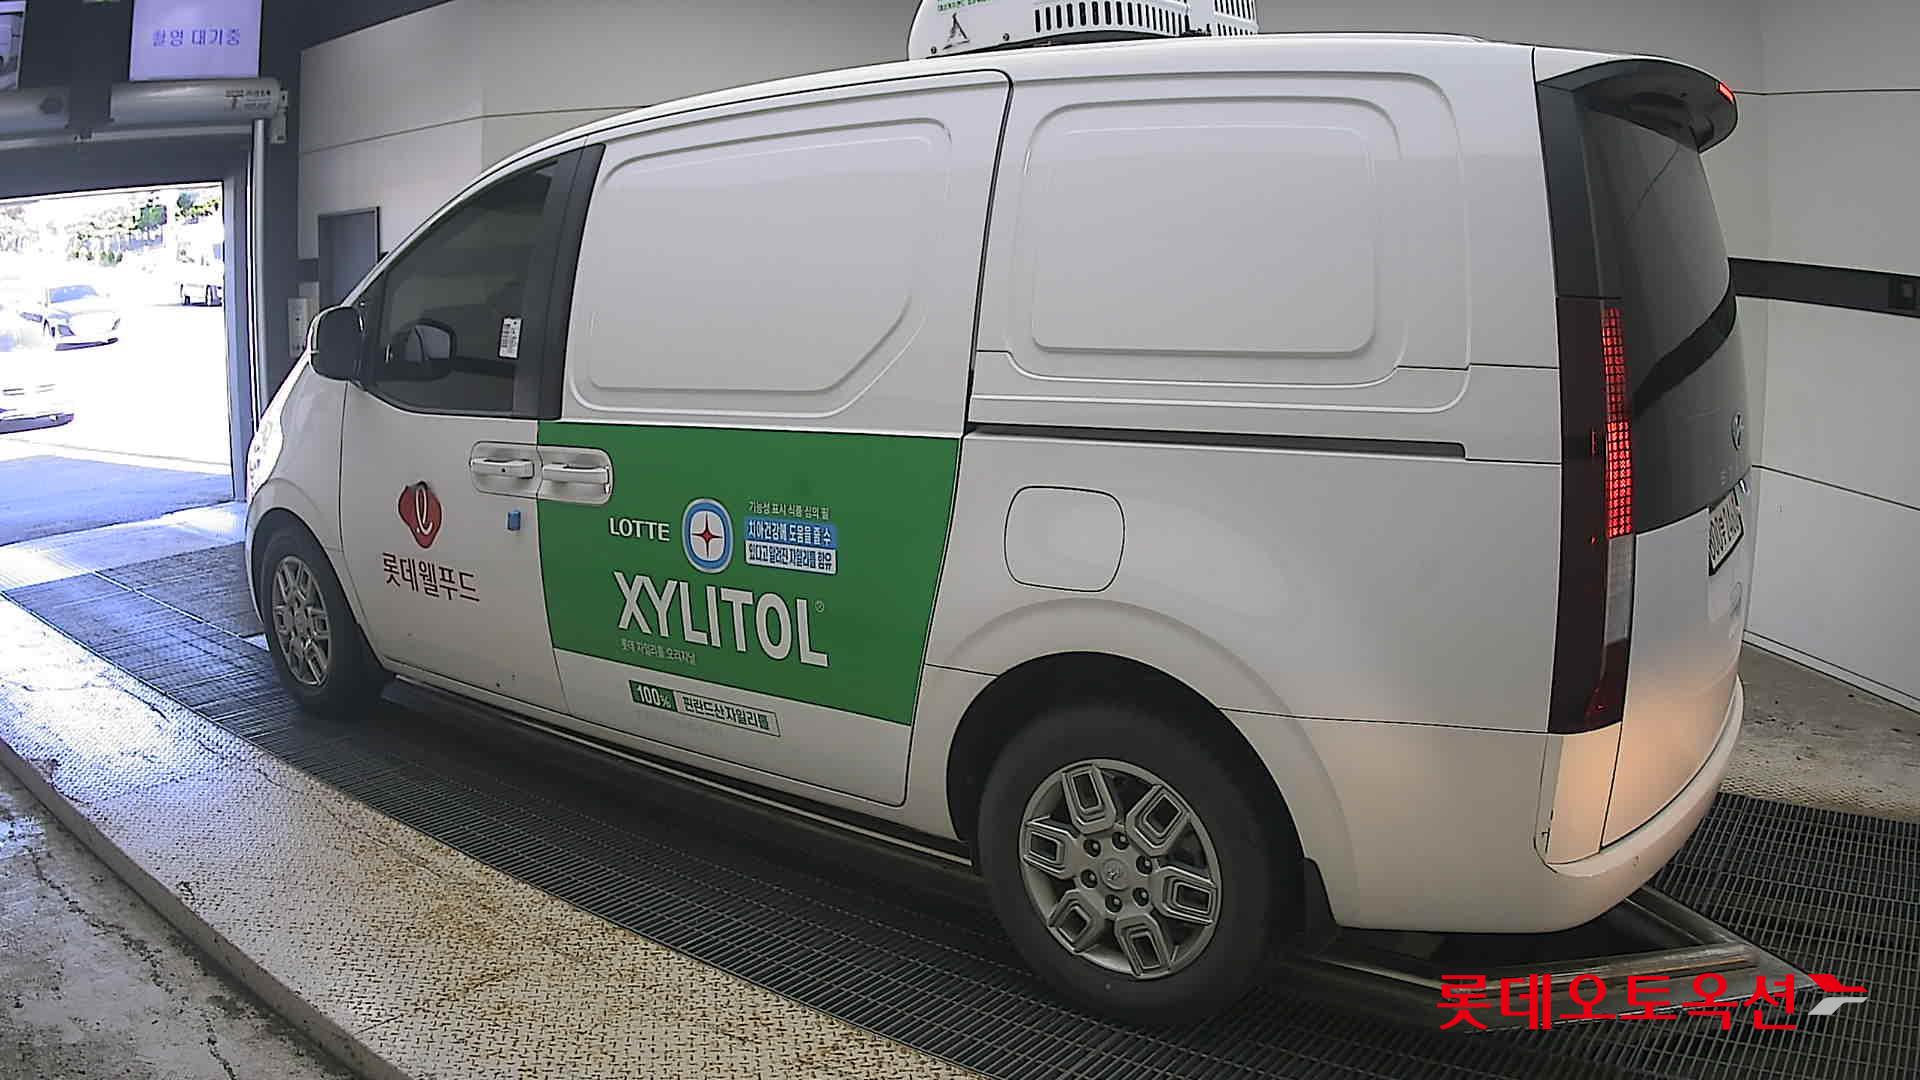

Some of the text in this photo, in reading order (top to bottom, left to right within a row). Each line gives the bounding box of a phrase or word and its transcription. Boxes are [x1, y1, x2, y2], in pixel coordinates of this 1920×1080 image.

[191, 27, 241, 47] 대기중
[772, 503, 787, 516] 표시
[609, 517, 671, 542] LOTTE
[789, 523, 812, 545] 도움을
[823, 527, 832, 547] 수
[817, 551, 833, 572] 함유
[382, 551, 481, 603] 롯데웰푸드
[613, 571, 829, 668] XYLITOL
[636, 684, 673, 708] 100%
